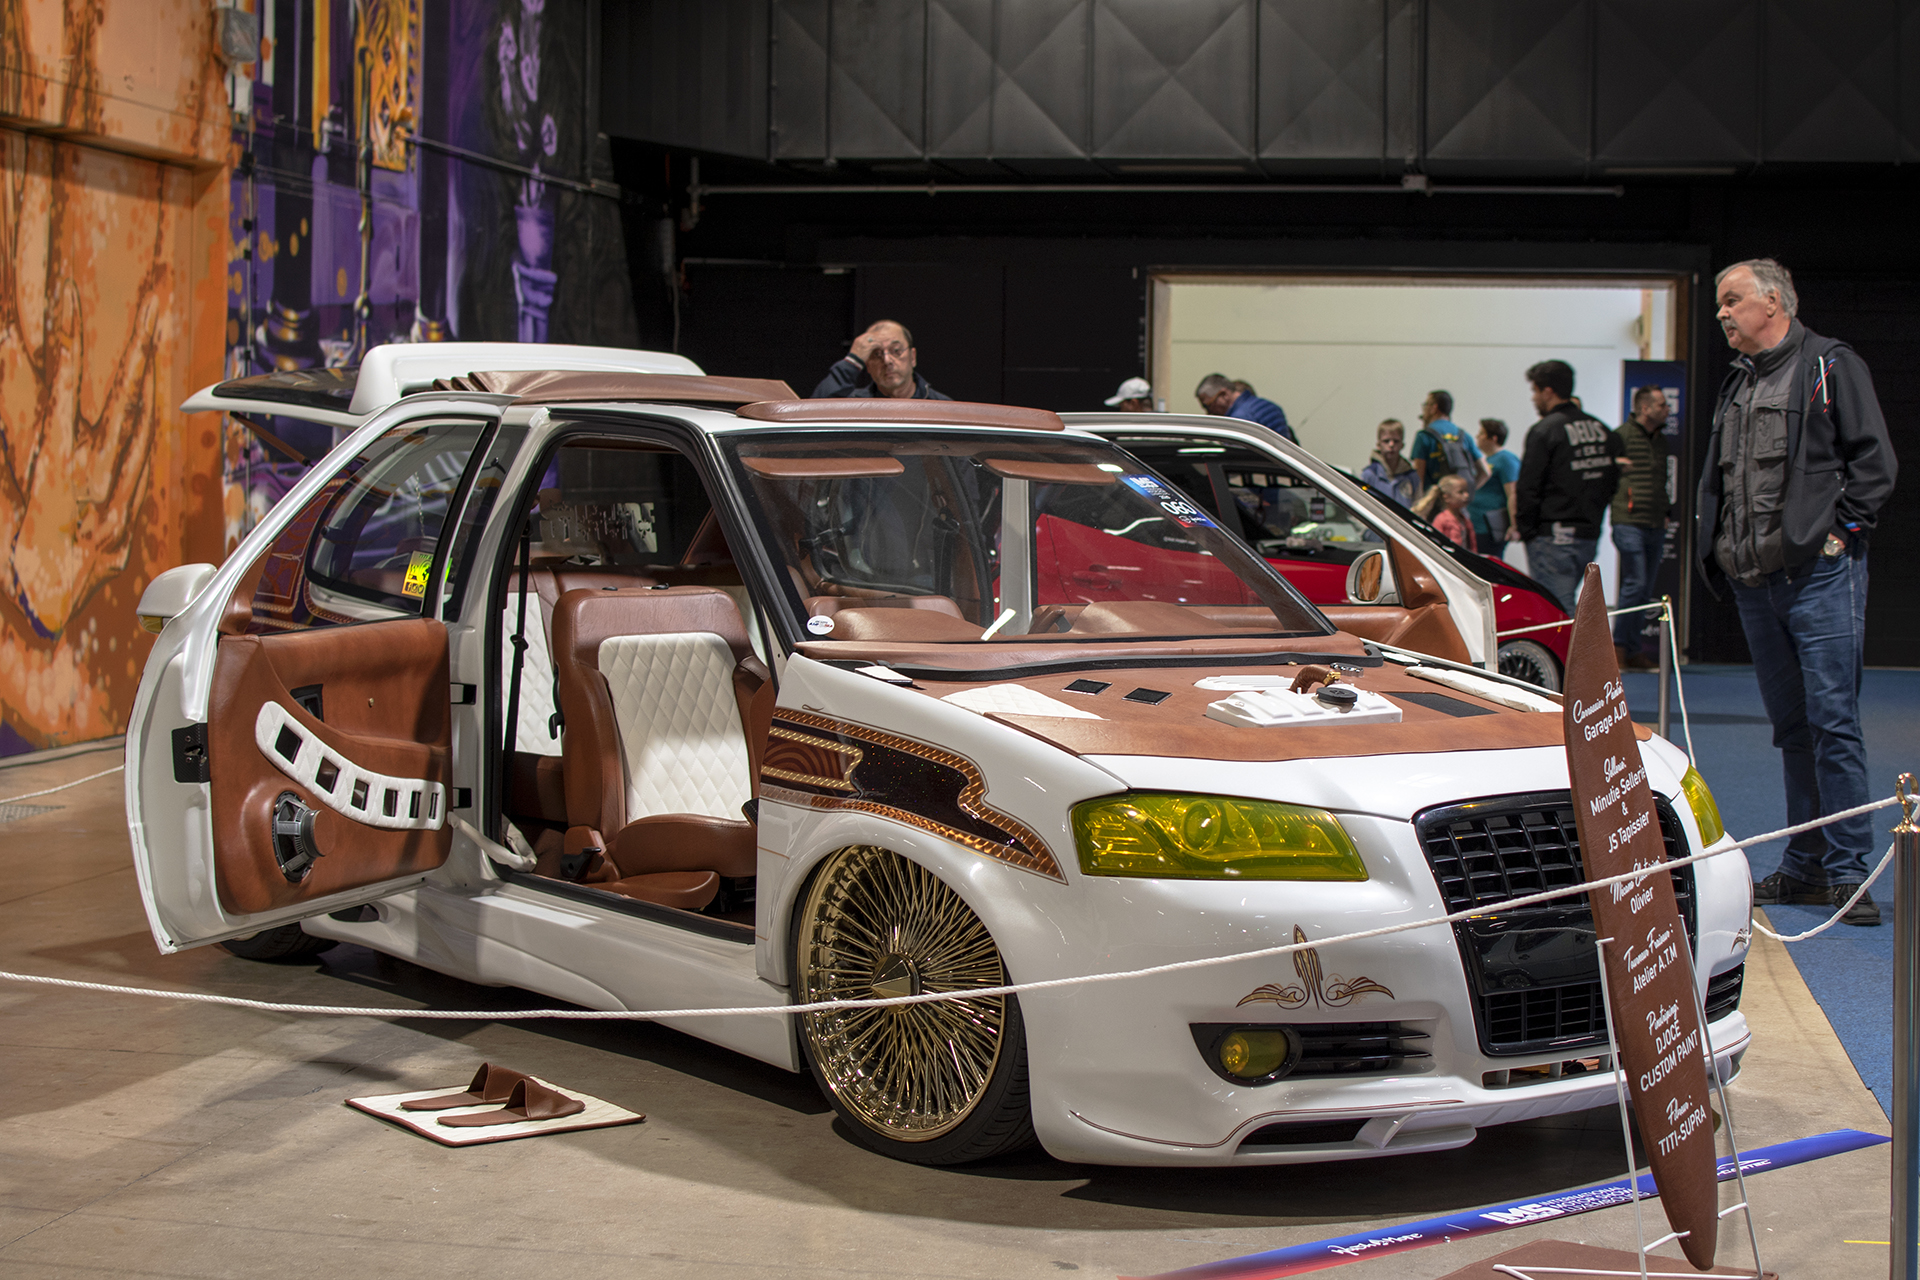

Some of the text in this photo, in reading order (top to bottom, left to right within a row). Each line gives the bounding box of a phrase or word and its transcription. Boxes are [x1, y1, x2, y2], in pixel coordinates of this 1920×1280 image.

[1564, 420, 1607, 446] DEUS
[1584, 700, 1628, 742] Garage AJD
[1590, 764, 1646, 816] Minutie Sellerie
[1621, 801, 1629, 816] &
[1608, 810, 1650, 853] JS Tapissier
[1630, 886, 1654, 914] Olivier
[1633, 942, 1678, 994] Atelier A.T.M
[1655, 1019, 1681, 1054] DJOCE
[1640, 1028, 1698, 1091] CUSTOM PAINT
[1658, 1104, 1707, 1156] TITI-SUPRA
